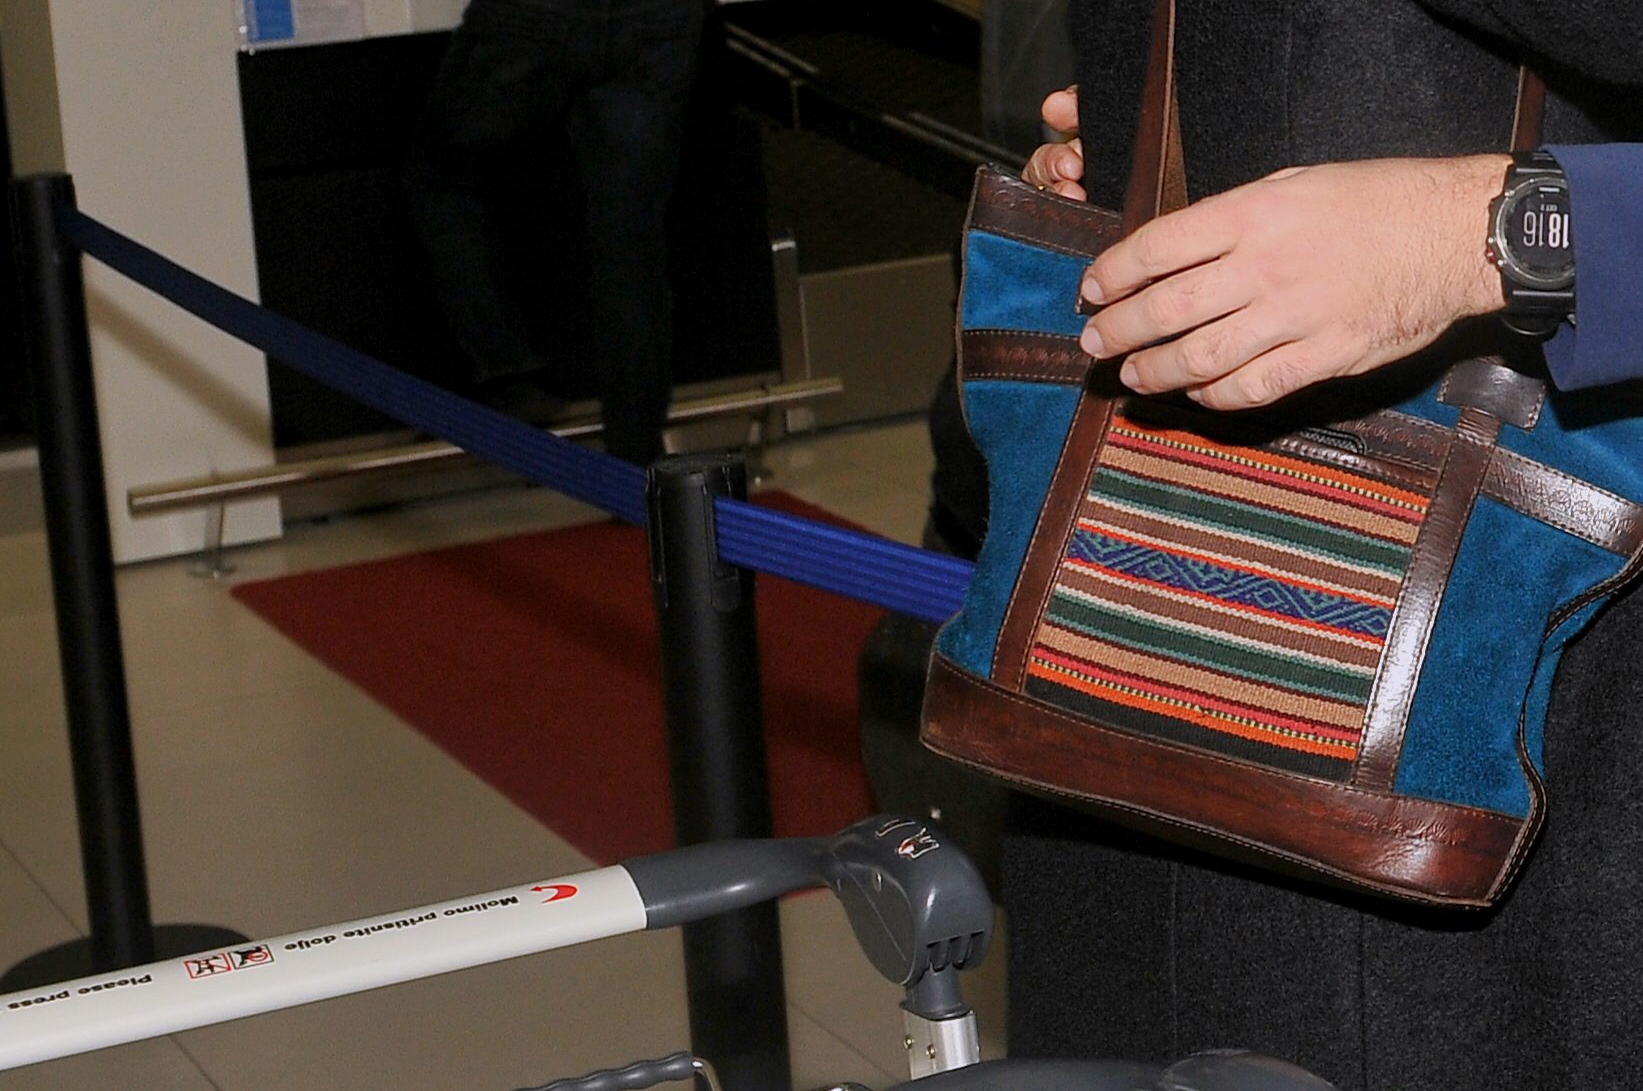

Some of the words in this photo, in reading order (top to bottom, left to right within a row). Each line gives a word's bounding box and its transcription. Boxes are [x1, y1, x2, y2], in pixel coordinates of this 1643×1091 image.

[444, 895, 520, 918] Molimo
[343, 911, 438, 938] pritisnite
[284, 934, 337, 950] dolje
[77, 973, 153, 995] Please
[7, 989, 70, 1010] press
